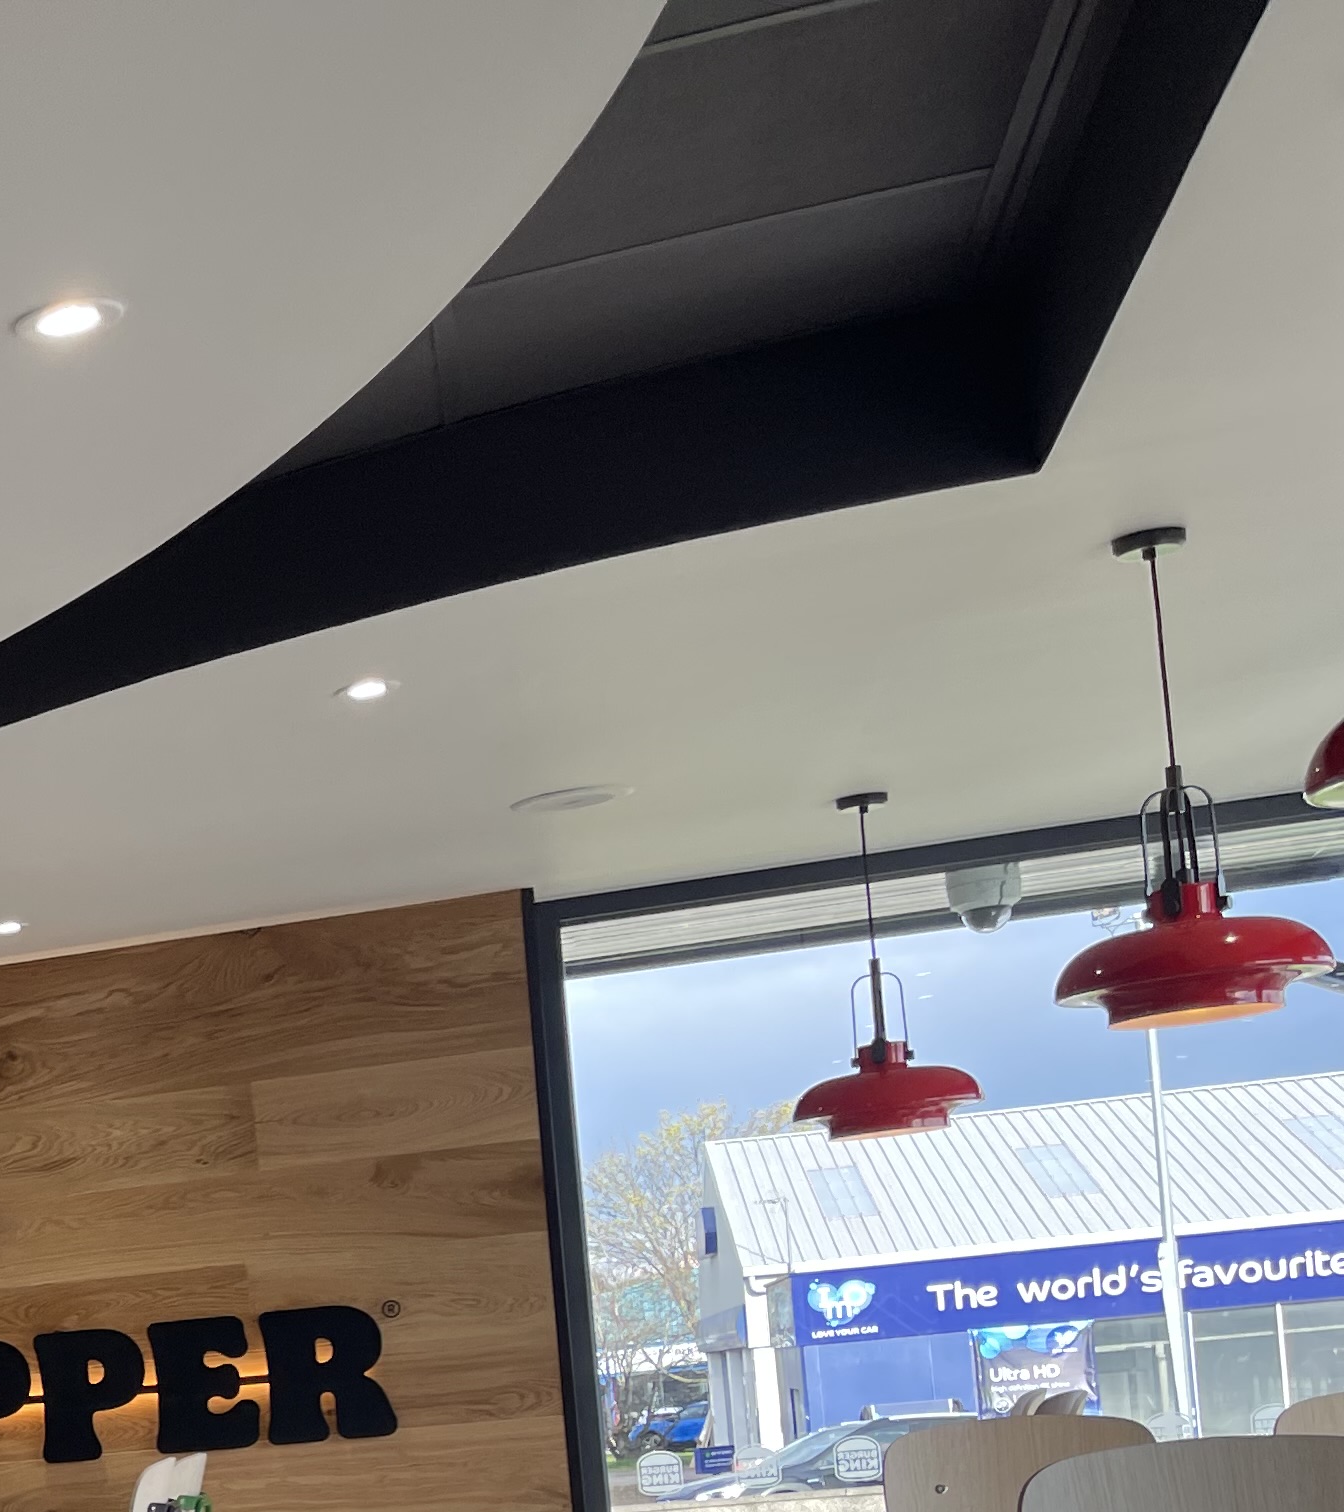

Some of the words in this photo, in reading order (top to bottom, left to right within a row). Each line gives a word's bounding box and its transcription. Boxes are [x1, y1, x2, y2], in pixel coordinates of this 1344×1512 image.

[926, 1281, 999, 1312] The
[1016, 1263, 1162, 1304] world's
[811, 1329, 835, 1339] LOVE
[835, 1327, 860, 1337] YOUR
[860, 1325, 879, 1335] CAR
[989, 1366, 1031, 1383] Ultra
[1032, 1363, 1061, 1380] HD
